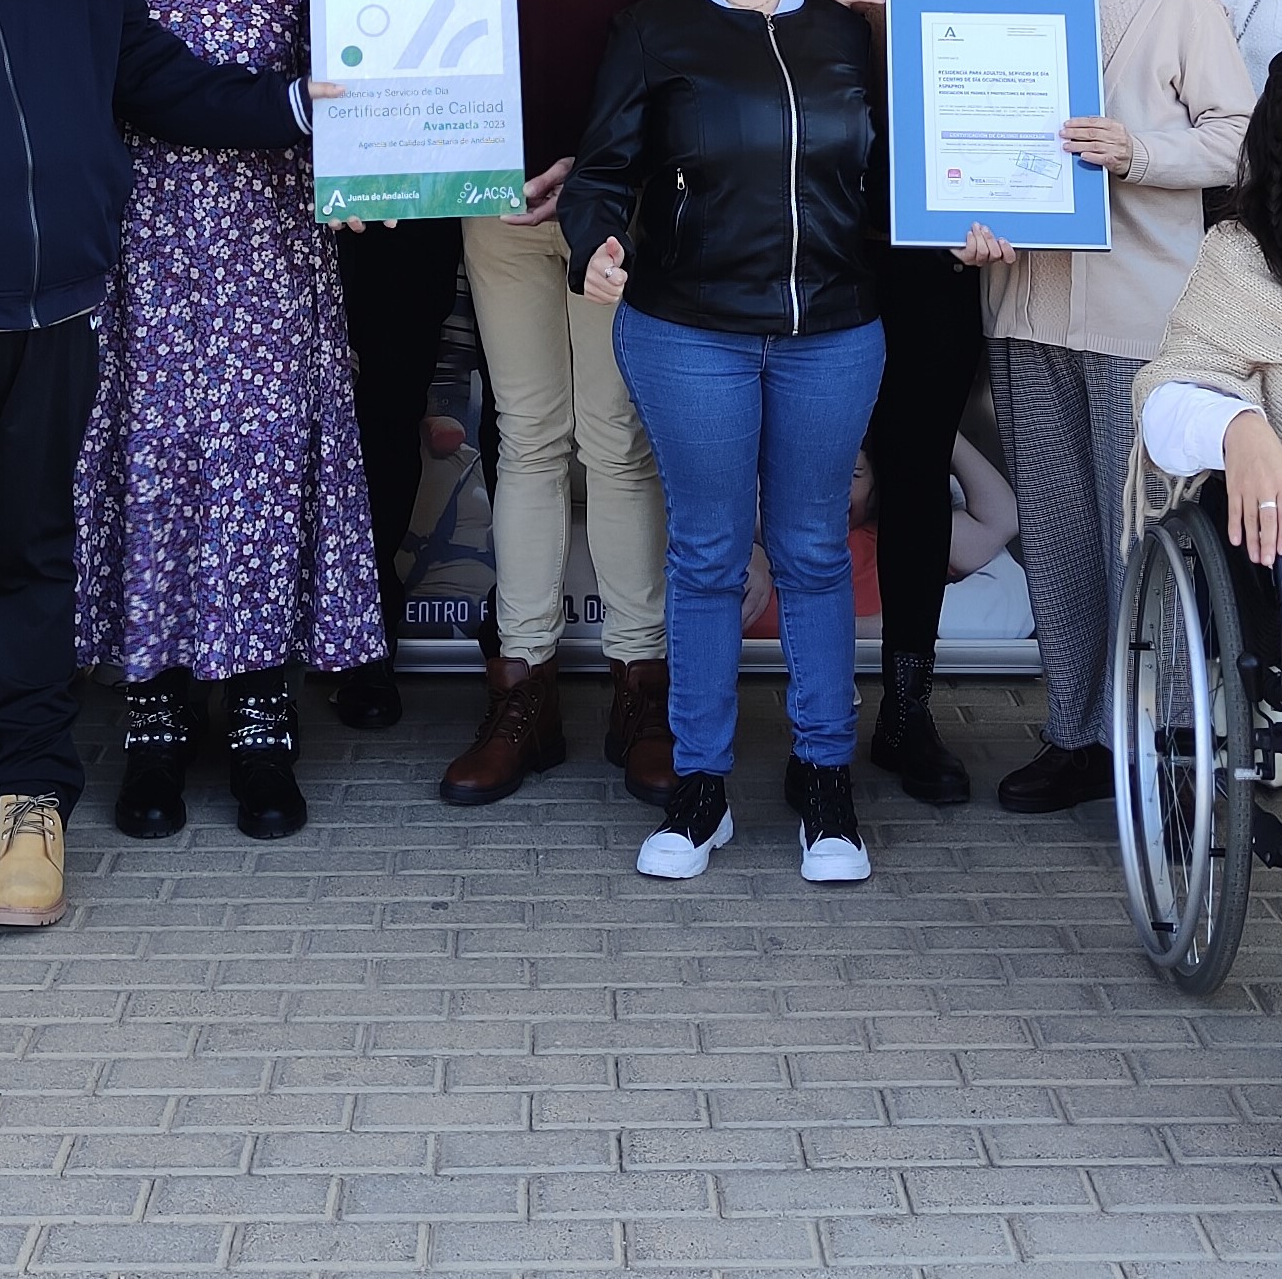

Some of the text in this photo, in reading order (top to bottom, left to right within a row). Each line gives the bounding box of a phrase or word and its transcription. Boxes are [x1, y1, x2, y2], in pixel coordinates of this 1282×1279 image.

[377, 90, 383, 99] y
[385, 88, 419, 97] Servicio
[421, 86, 433, 96] de
[328, 100, 504, 119] Certificación de Calidad
[423, 120, 505, 131] Avanzada 2023
[358, 142, 387, 150] Agencia
[389, 140, 397, 148] de
[399, 139, 426, 148] Calidad
[427, 138, 459, 146] Sanitaria
[347, 190, 420, 202] Junta de Andalucía
[483, 186, 515, 200] ACSA
[405, 600, 469, 622] ENTRO
